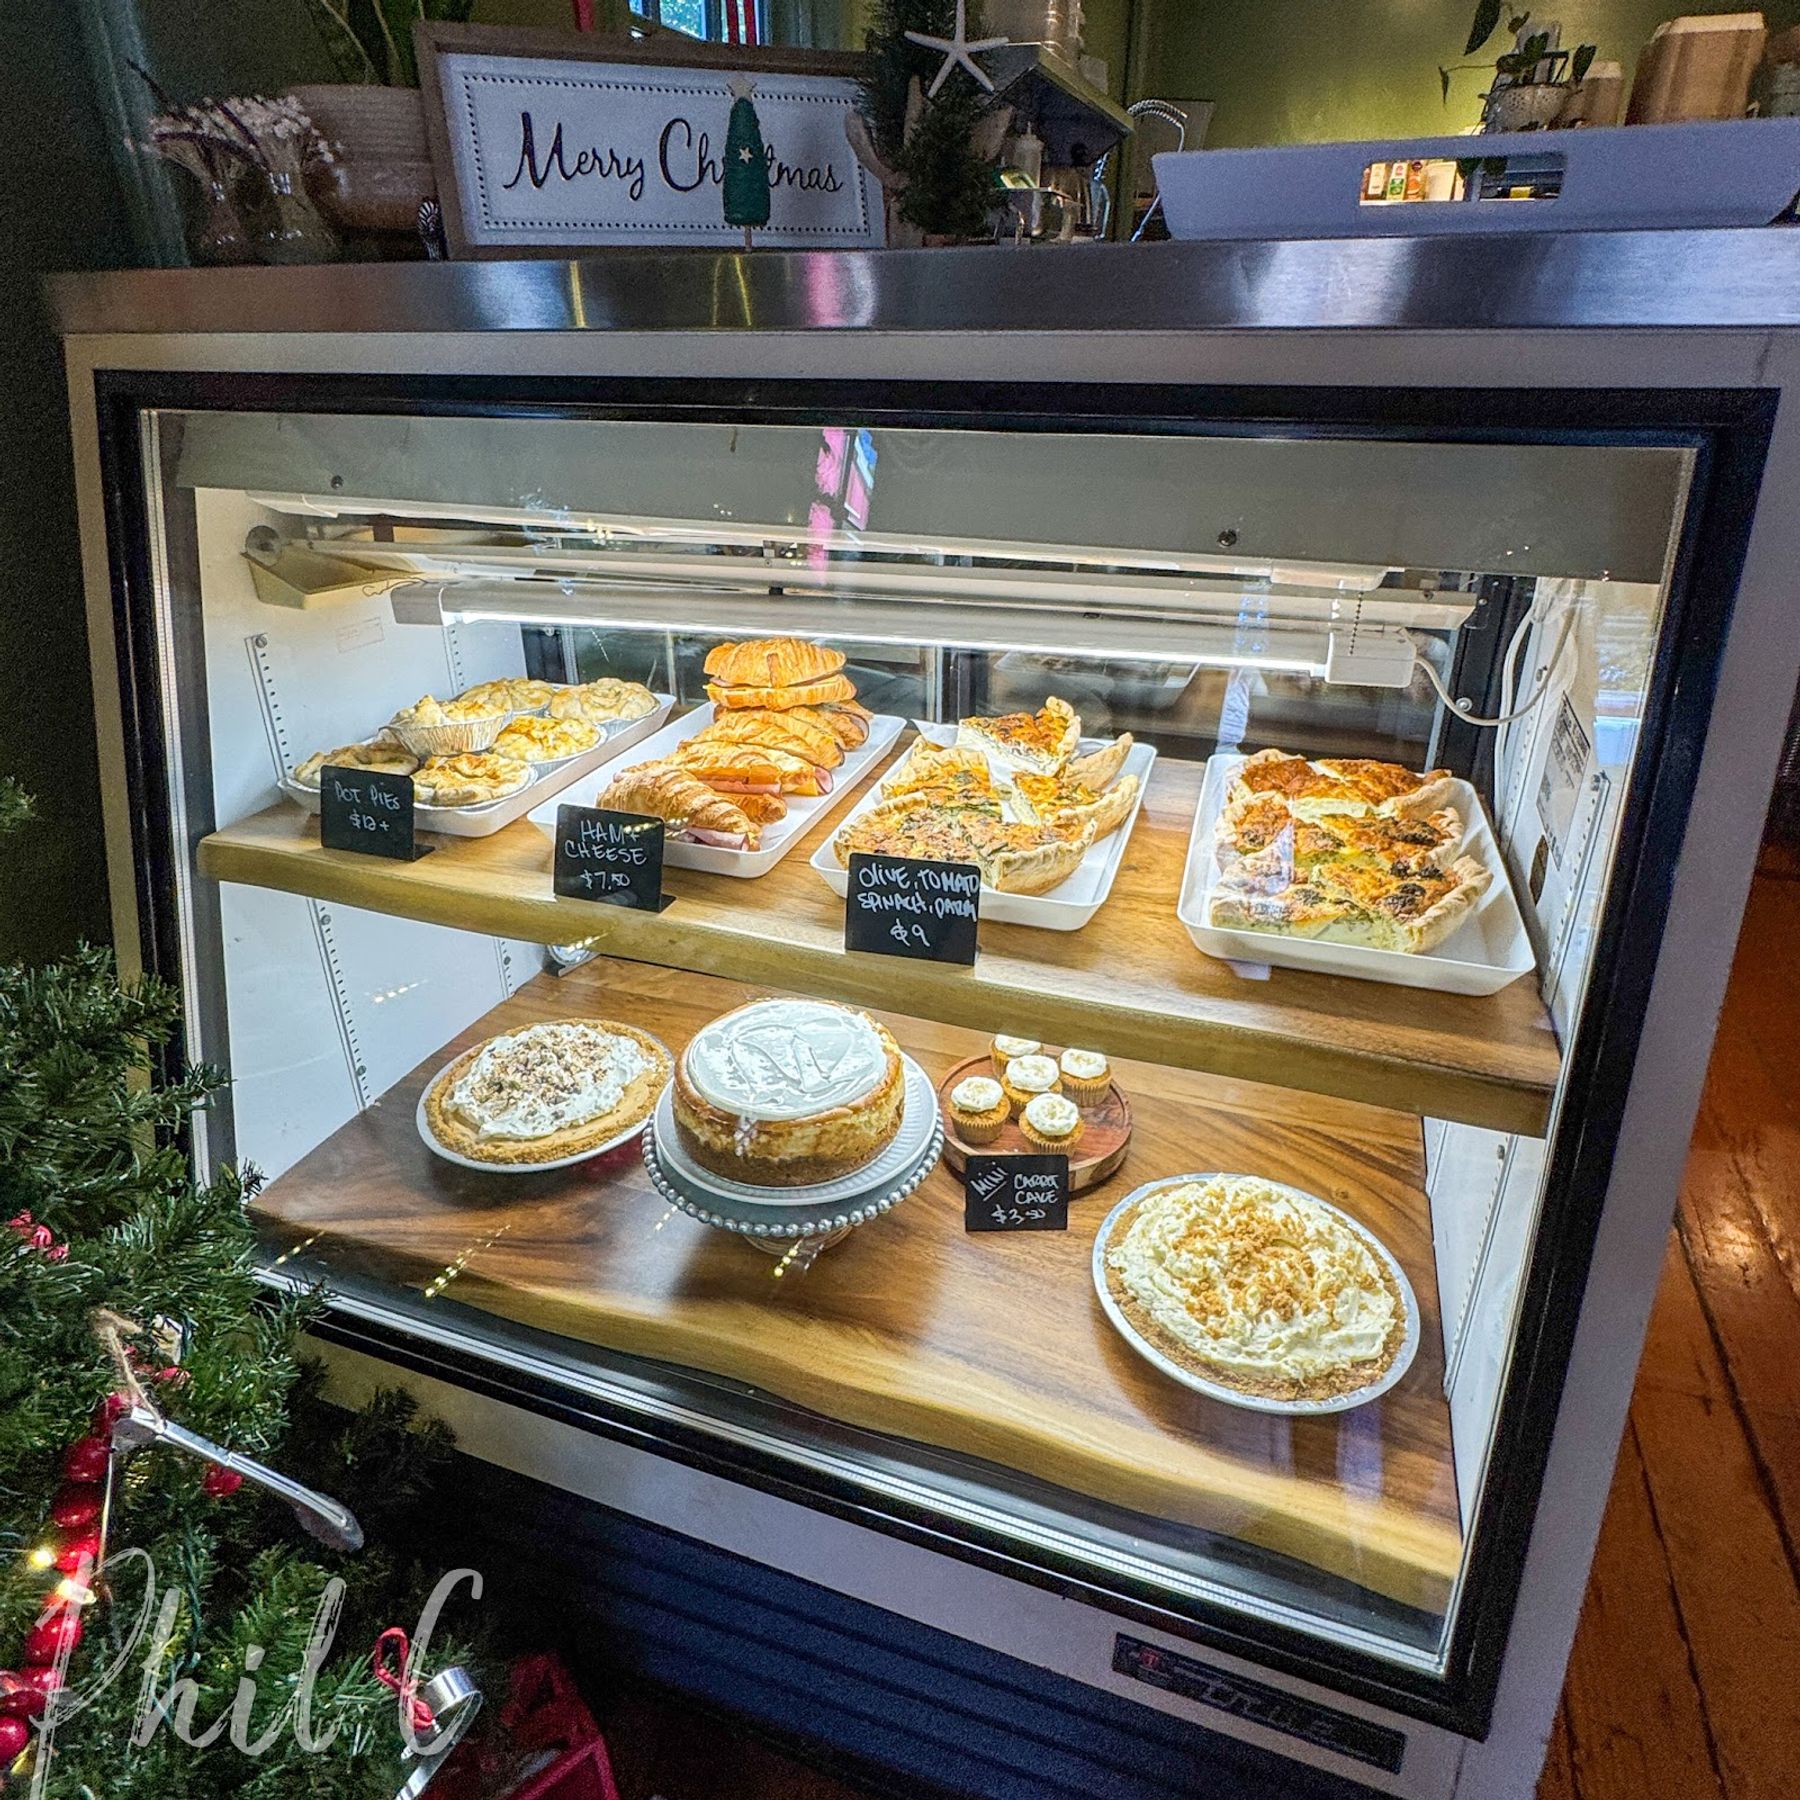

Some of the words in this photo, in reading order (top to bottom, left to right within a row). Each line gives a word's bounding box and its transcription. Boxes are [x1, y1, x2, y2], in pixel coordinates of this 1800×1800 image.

[502, 111, 645, 202] Merry
[658, 117, 844, 193] Chtmas
[334, 780, 361, 803] POT
[580, 819, 625, 845] HAM
[564, 839, 648, 866] CHEESE
[580, 868, 632, 891] $7.50
[889, 918, 931, 947] $9
